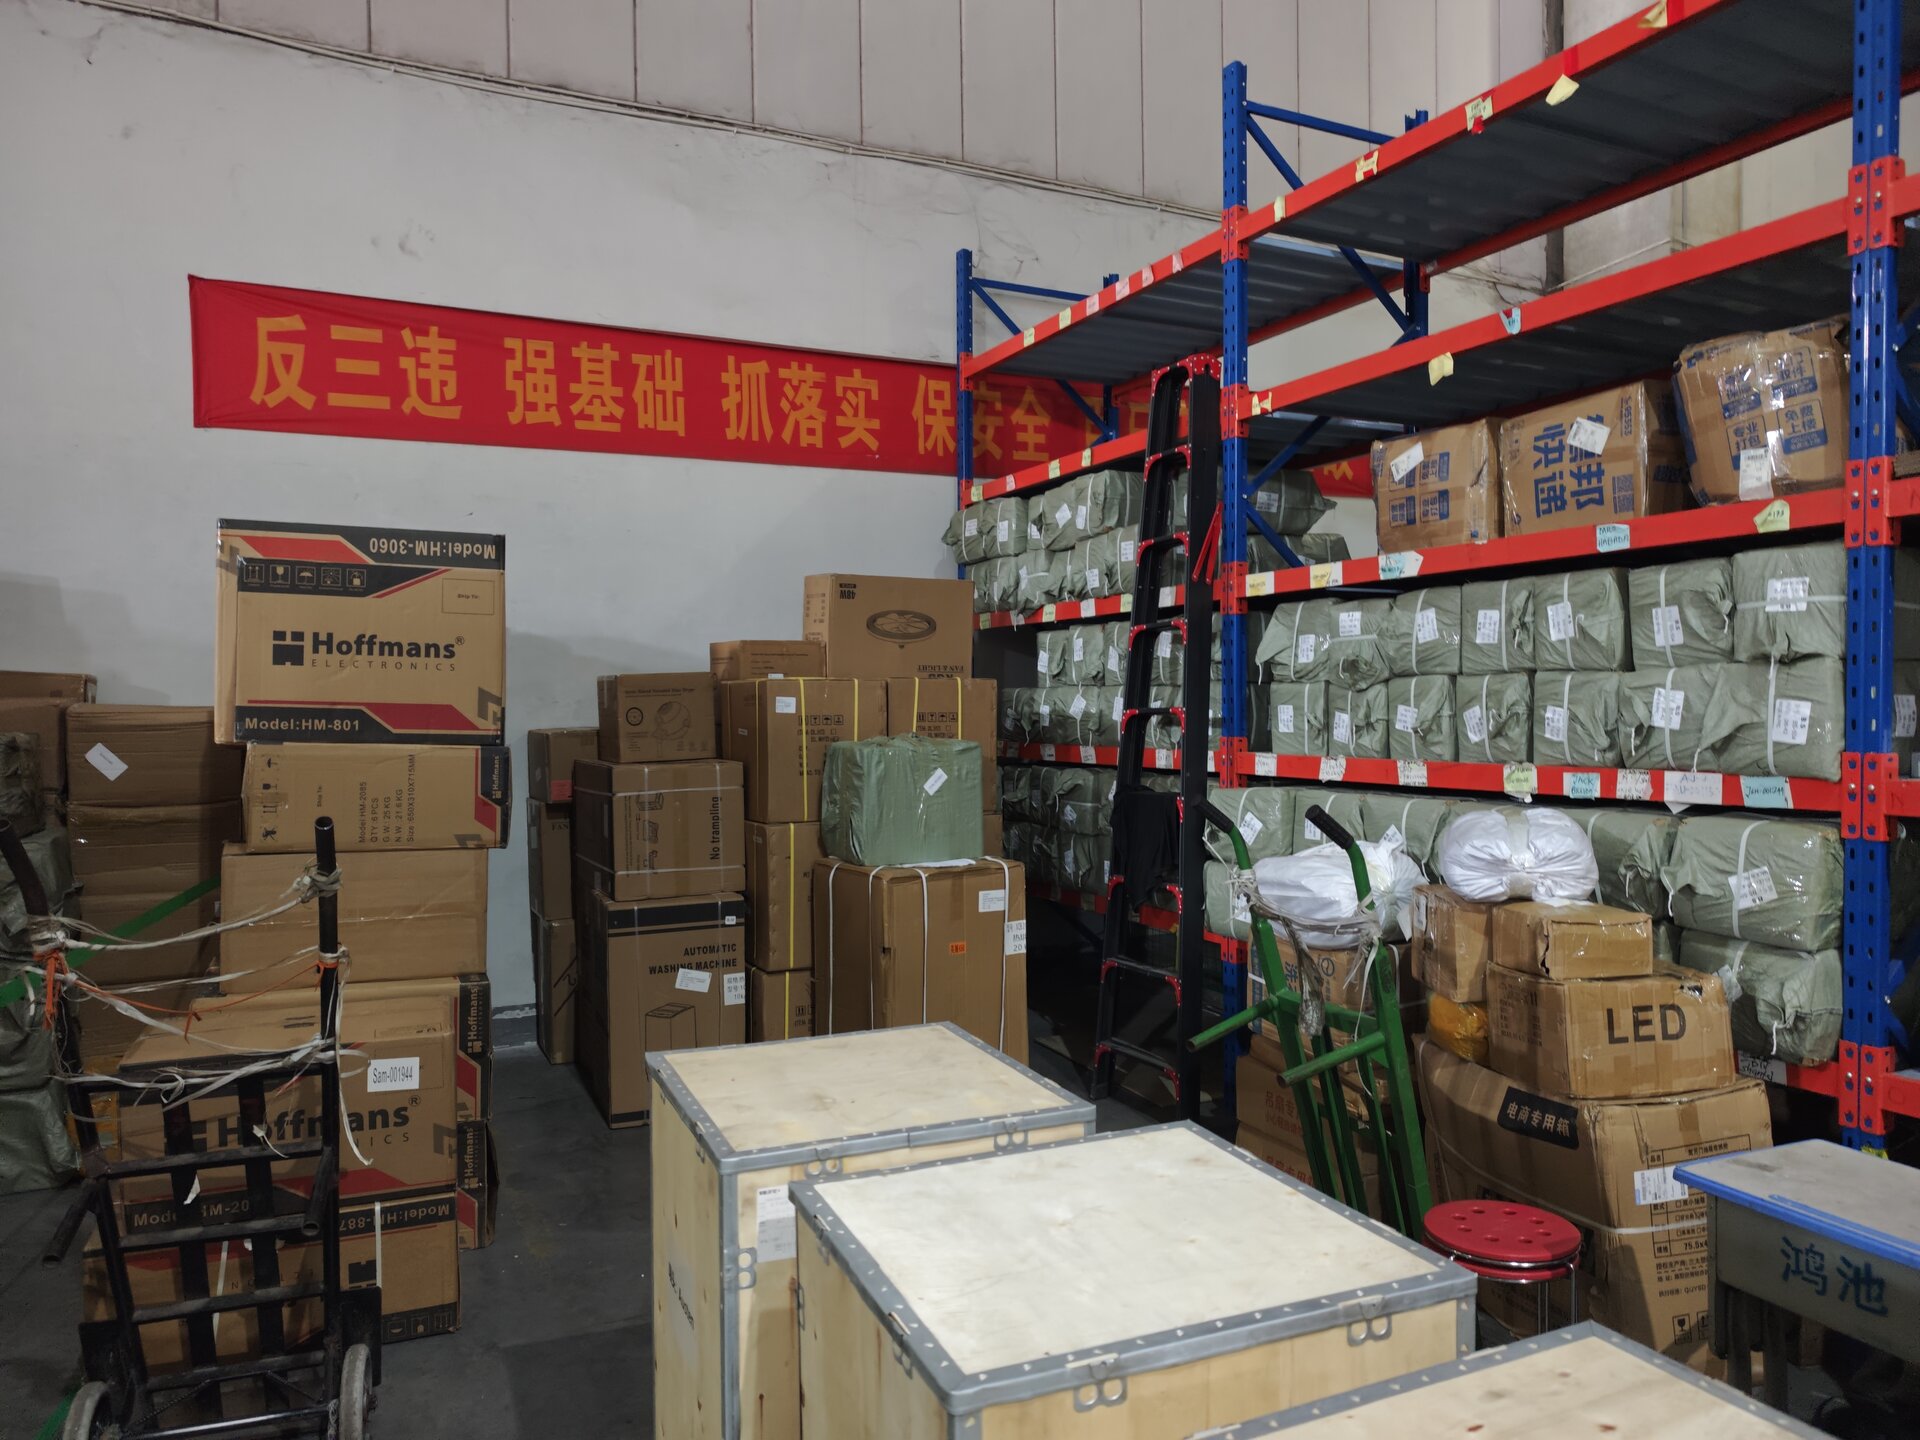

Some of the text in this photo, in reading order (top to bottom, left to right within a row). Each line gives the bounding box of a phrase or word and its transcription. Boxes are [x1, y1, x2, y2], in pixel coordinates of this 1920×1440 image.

[249, 314, 463, 421] 反三违
[503, 337, 687, 437] 强基础
[722, 354, 881, 451] 抓落实
[1533, 422, 1568, 519] 快递
[369, 537, 497, 559] Model:HM-3060
[311, 658, 456, 672] ELECTRONICS
[245, 717, 360, 732] Model:HM-801
[710, 847, 720, 860] No
[684, 943, 737, 956] AUTOMATIC
[695, 958, 737, 971] MACHINE
[1606, 1003, 1688, 1045] LED
[372, 1066, 413, 1084] Sam-001944
[1506, 1101, 1571, 1137] 电商专用箱
[1780, 1236, 1889, 1317] 鸿池
